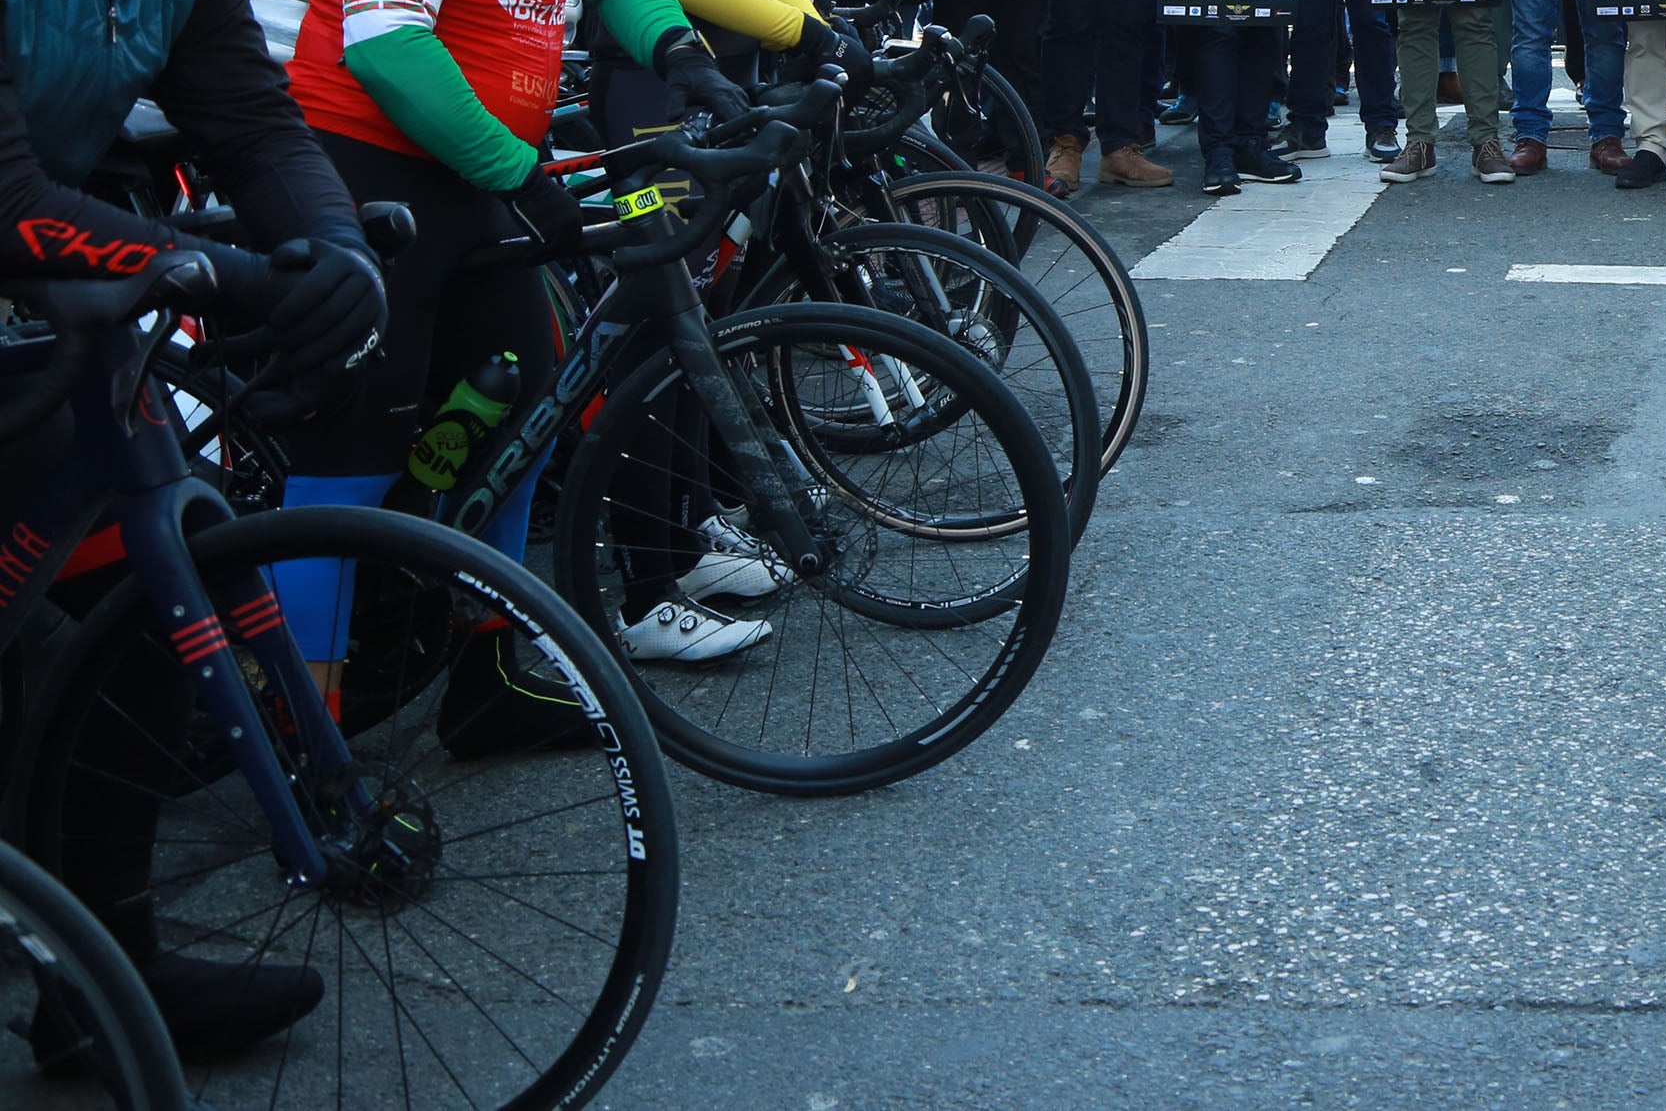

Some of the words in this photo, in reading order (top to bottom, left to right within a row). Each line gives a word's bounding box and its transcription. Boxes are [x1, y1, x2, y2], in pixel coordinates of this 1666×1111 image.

[718, 319, 762, 337] ZAFFIRO
[453, 321, 631, 535] ORBEA
[609, 756, 641, 820] SWISS
[625, 824, 647, 861] DT
